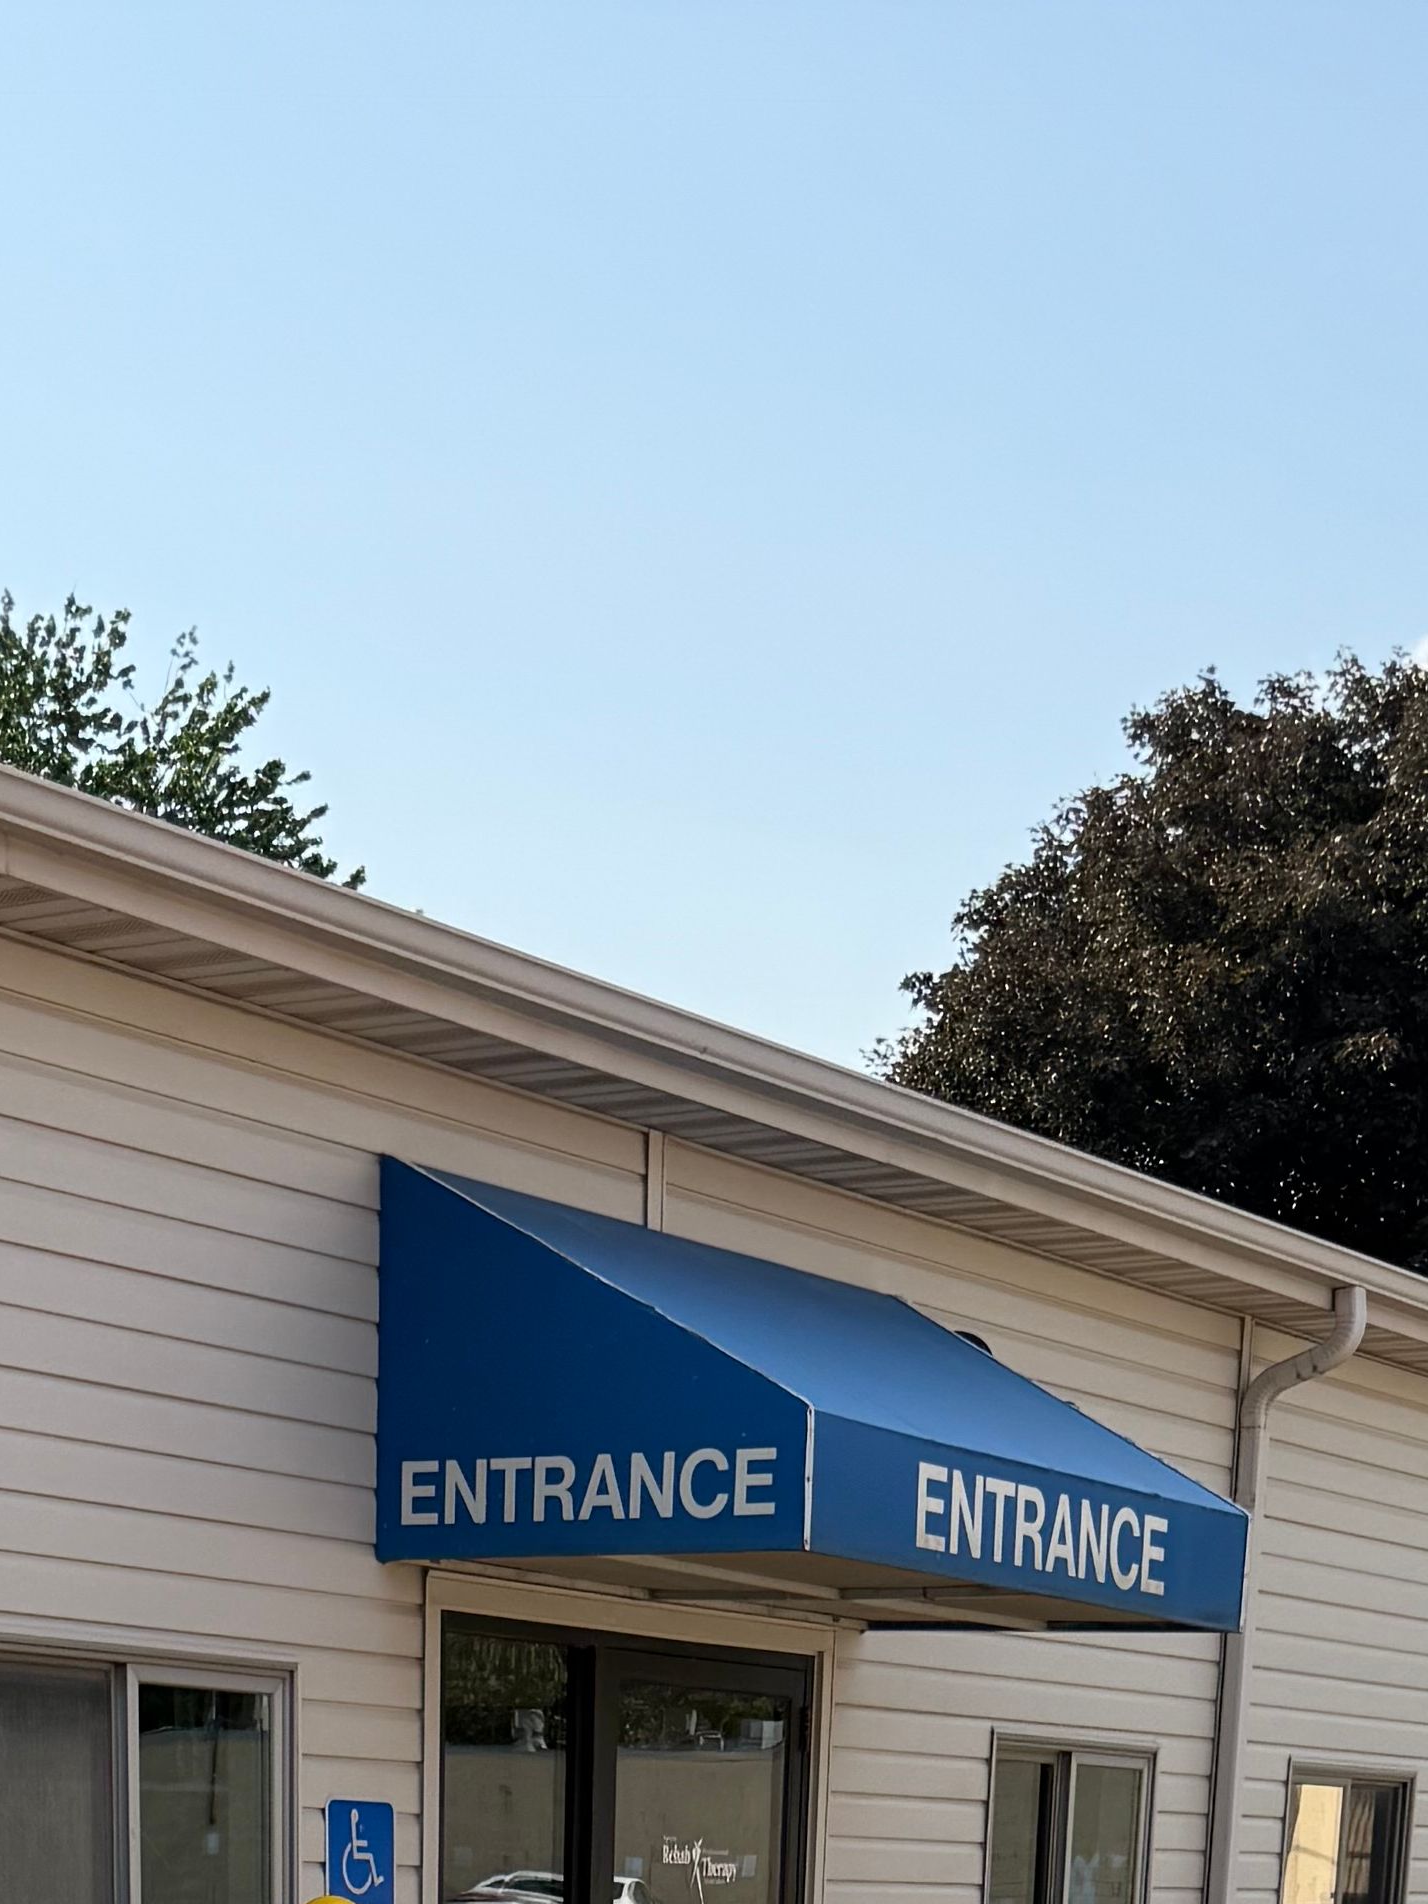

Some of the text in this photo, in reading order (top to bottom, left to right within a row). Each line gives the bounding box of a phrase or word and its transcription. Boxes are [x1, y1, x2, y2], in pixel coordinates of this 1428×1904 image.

[401, 1447, 777, 1525] ENTRANCE
[916, 1461, 1168, 1596] ENTRANCE
[663, 1843, 691, 1864] Rehab
[701, 1856, 736, 1883] Therapy
